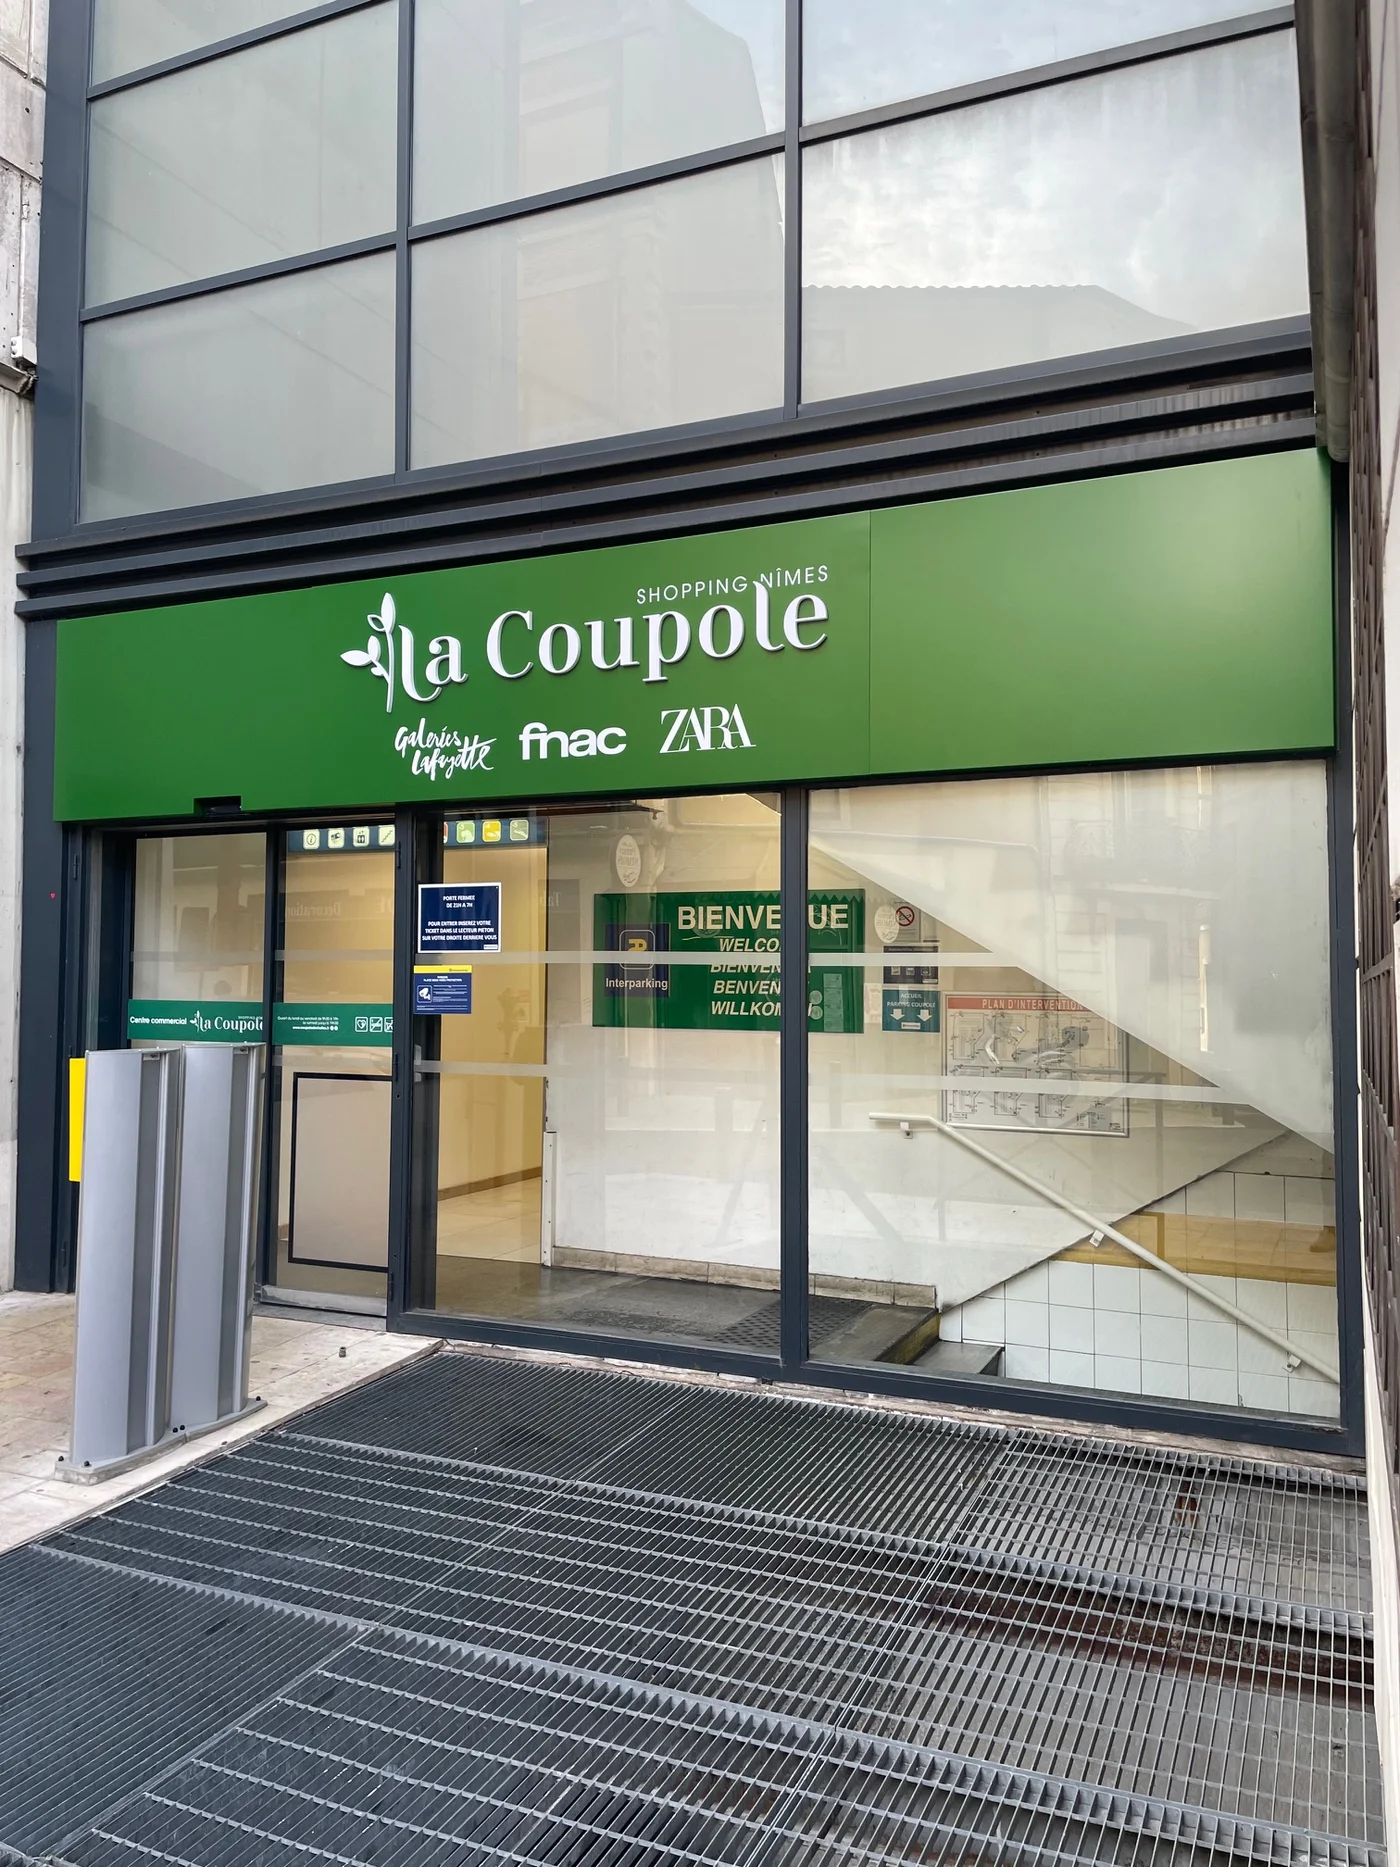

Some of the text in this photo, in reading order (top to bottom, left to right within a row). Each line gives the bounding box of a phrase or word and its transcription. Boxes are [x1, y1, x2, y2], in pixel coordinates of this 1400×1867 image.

[636, 564, 830, 605] SHOPPING NÎMES
[398, 578, 829, 702] la Coupole
[394, 717, 462, 759] Galeries
[519, 721, 628, 761] fnac
[659, 703, 757, 754] ZARA
[411, 734, 498, 781] Lafayette
[677, 904, 849, 930] BIENVEUE
[719, 937, 781, 952] WELCO
[605, 977, 669, 991] Interparking
[982, 999, 1004, 1009] PLAN
[129, 1016, 150, 1024] Centre
[151, 1017, 187, 1025] commercial
[200, 1016, 211, 1032] la
